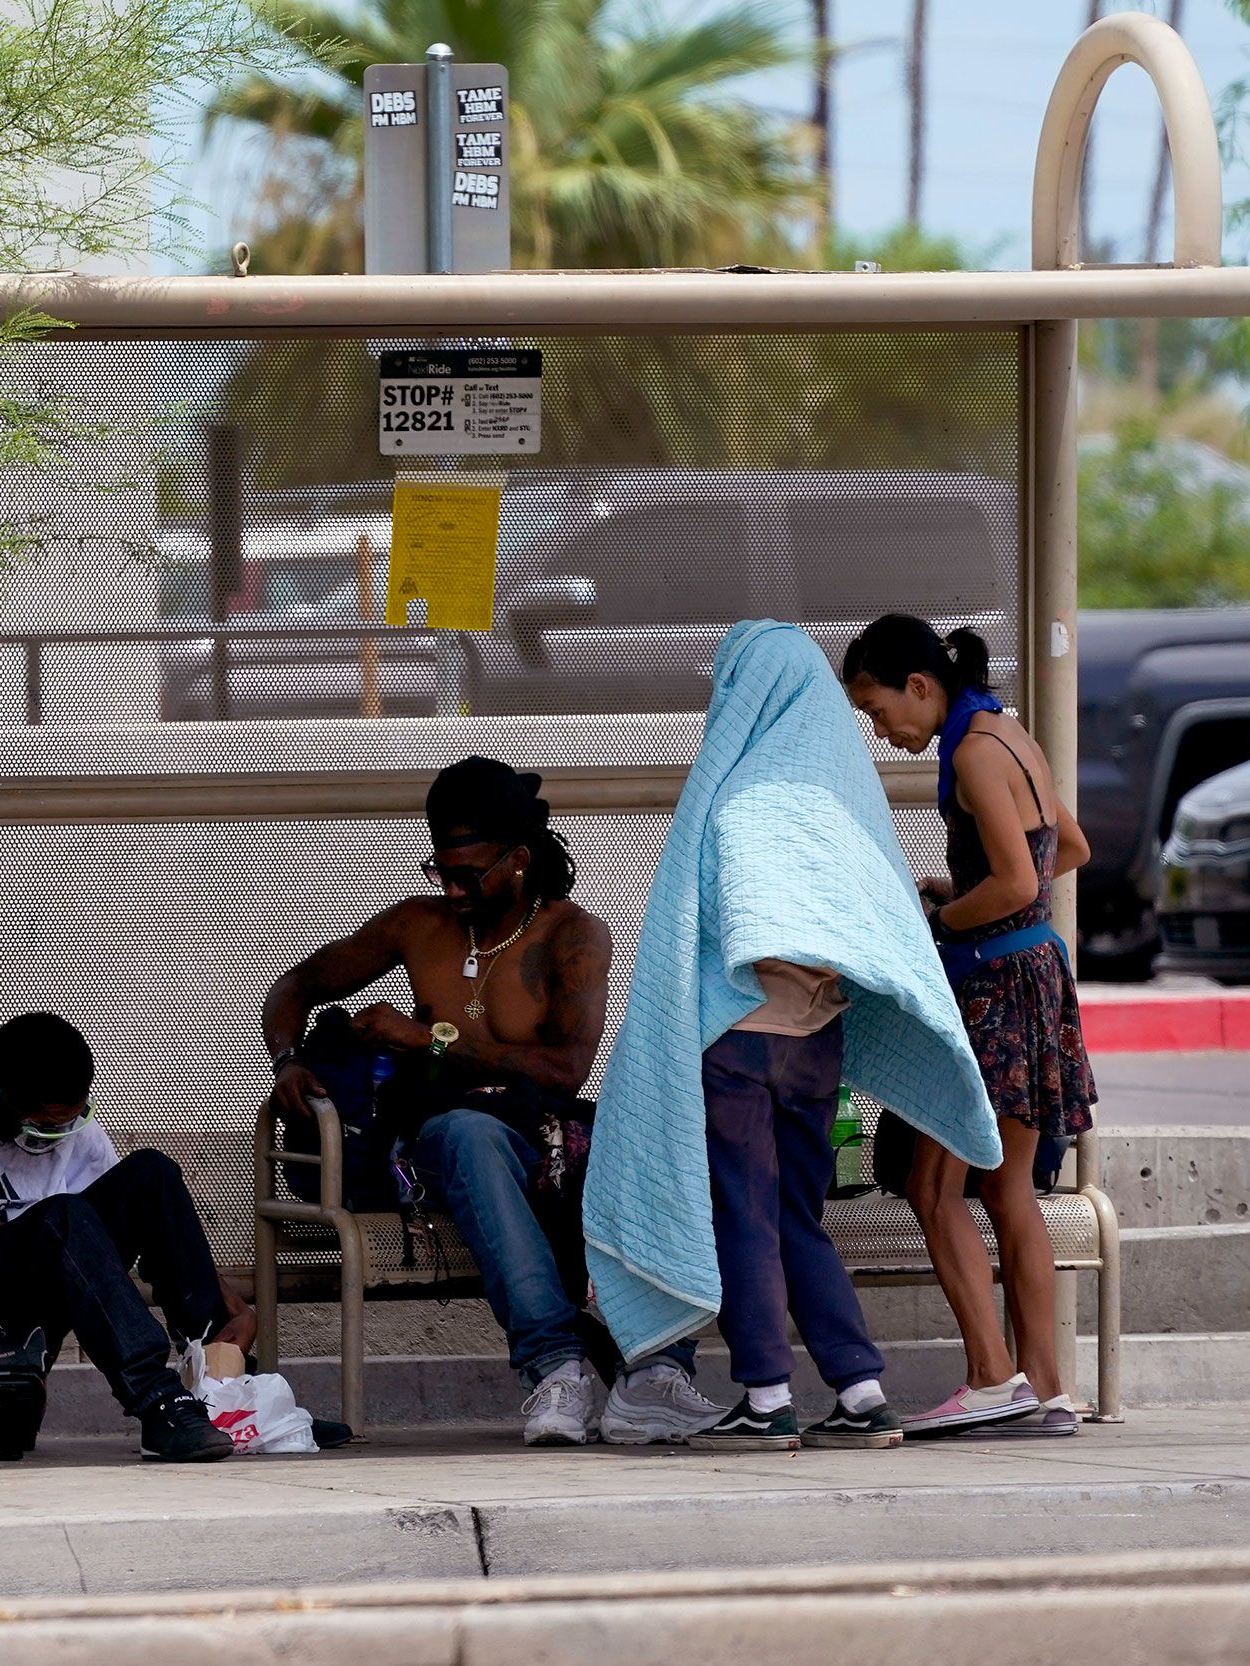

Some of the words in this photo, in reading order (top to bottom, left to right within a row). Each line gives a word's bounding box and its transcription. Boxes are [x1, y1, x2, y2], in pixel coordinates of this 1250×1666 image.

[457, 88, 502, 102] TAME
[371, 92, 416, 113] DEBS
[465, 101, 497, 113] HBM
[372, 115, 389, 126] FM
[391, 112, 416, 125] HBM
[460, 112, 503, 123] FOREVER
[456, 133, 501, 146] TAME
[463, 146, 495, 157] HBM
[457, 157, 501, 167] FOREVER
[455, 172, 499, 195] DEBS
[471, 194, 497, 209] HBM
[487, 357, 517, 365] 253-5000
[383, 385, 454, 407] STOP#
[383, 410, 454, 432] 12821
